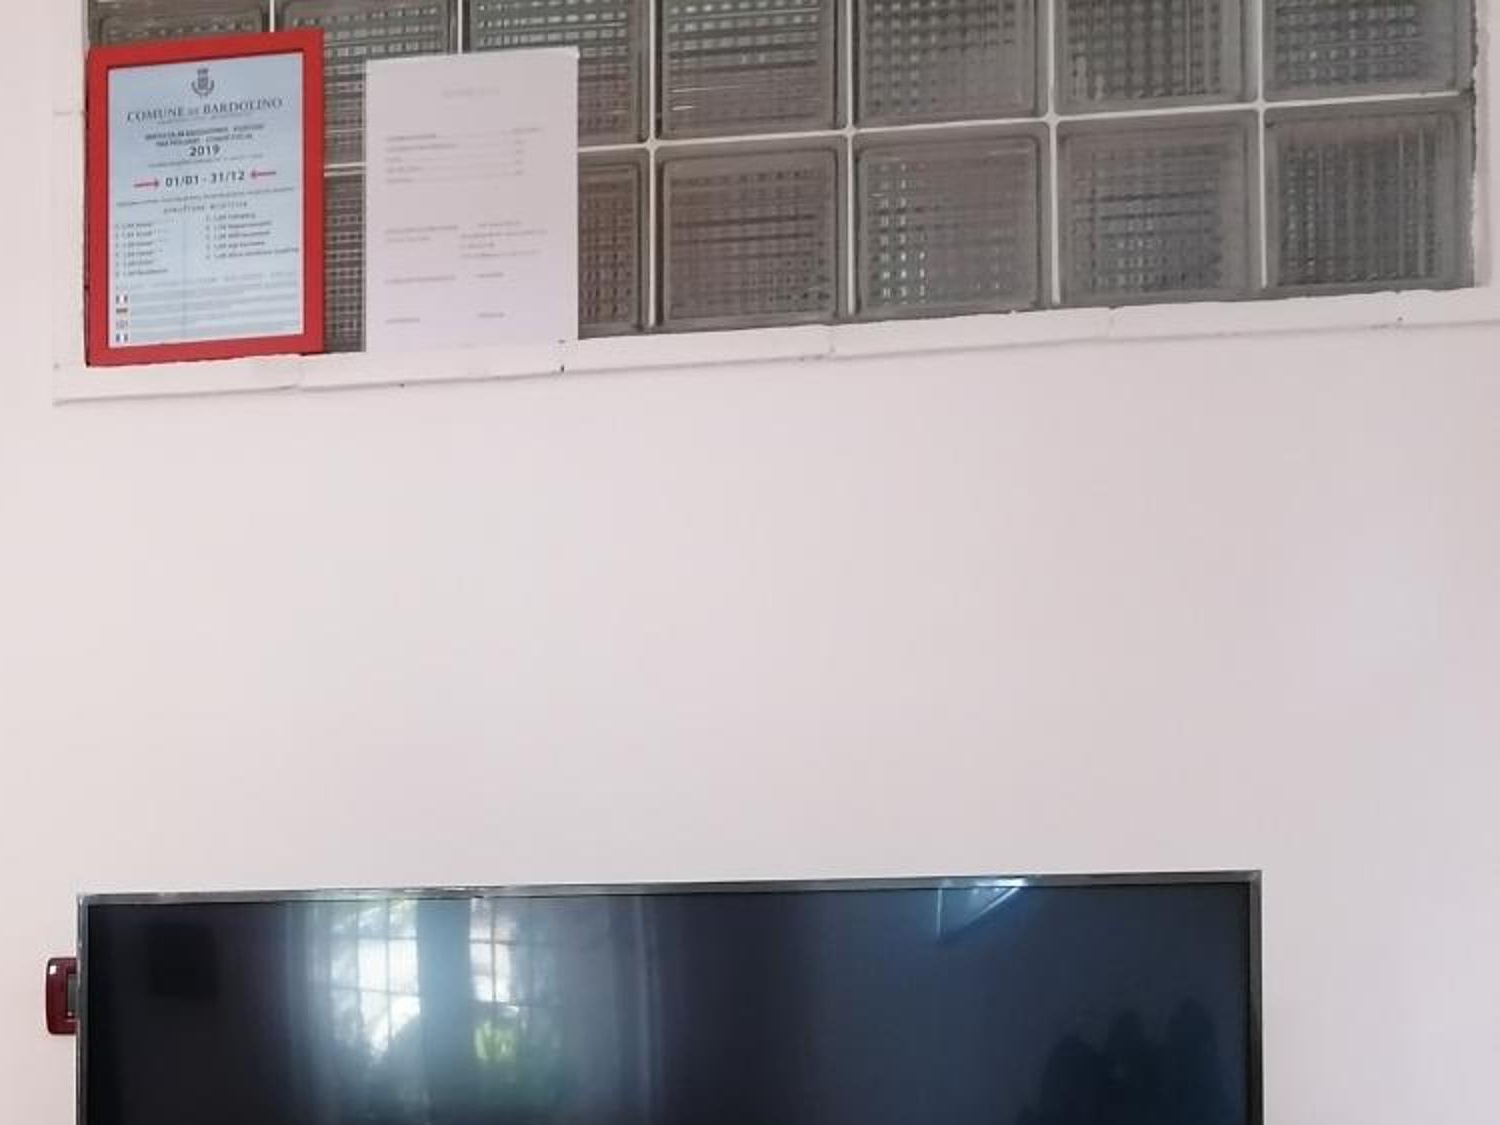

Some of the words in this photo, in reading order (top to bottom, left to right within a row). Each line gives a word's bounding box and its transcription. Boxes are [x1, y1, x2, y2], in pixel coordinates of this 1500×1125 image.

[127, 106, 183, 122] COMUNE
[203, 98, 283, 114] BARDOLINO
[188, 144, 221, 157] 2019
[165, 174, 199, 188] 01/01
[211, 171, 245, 185] 31/12
